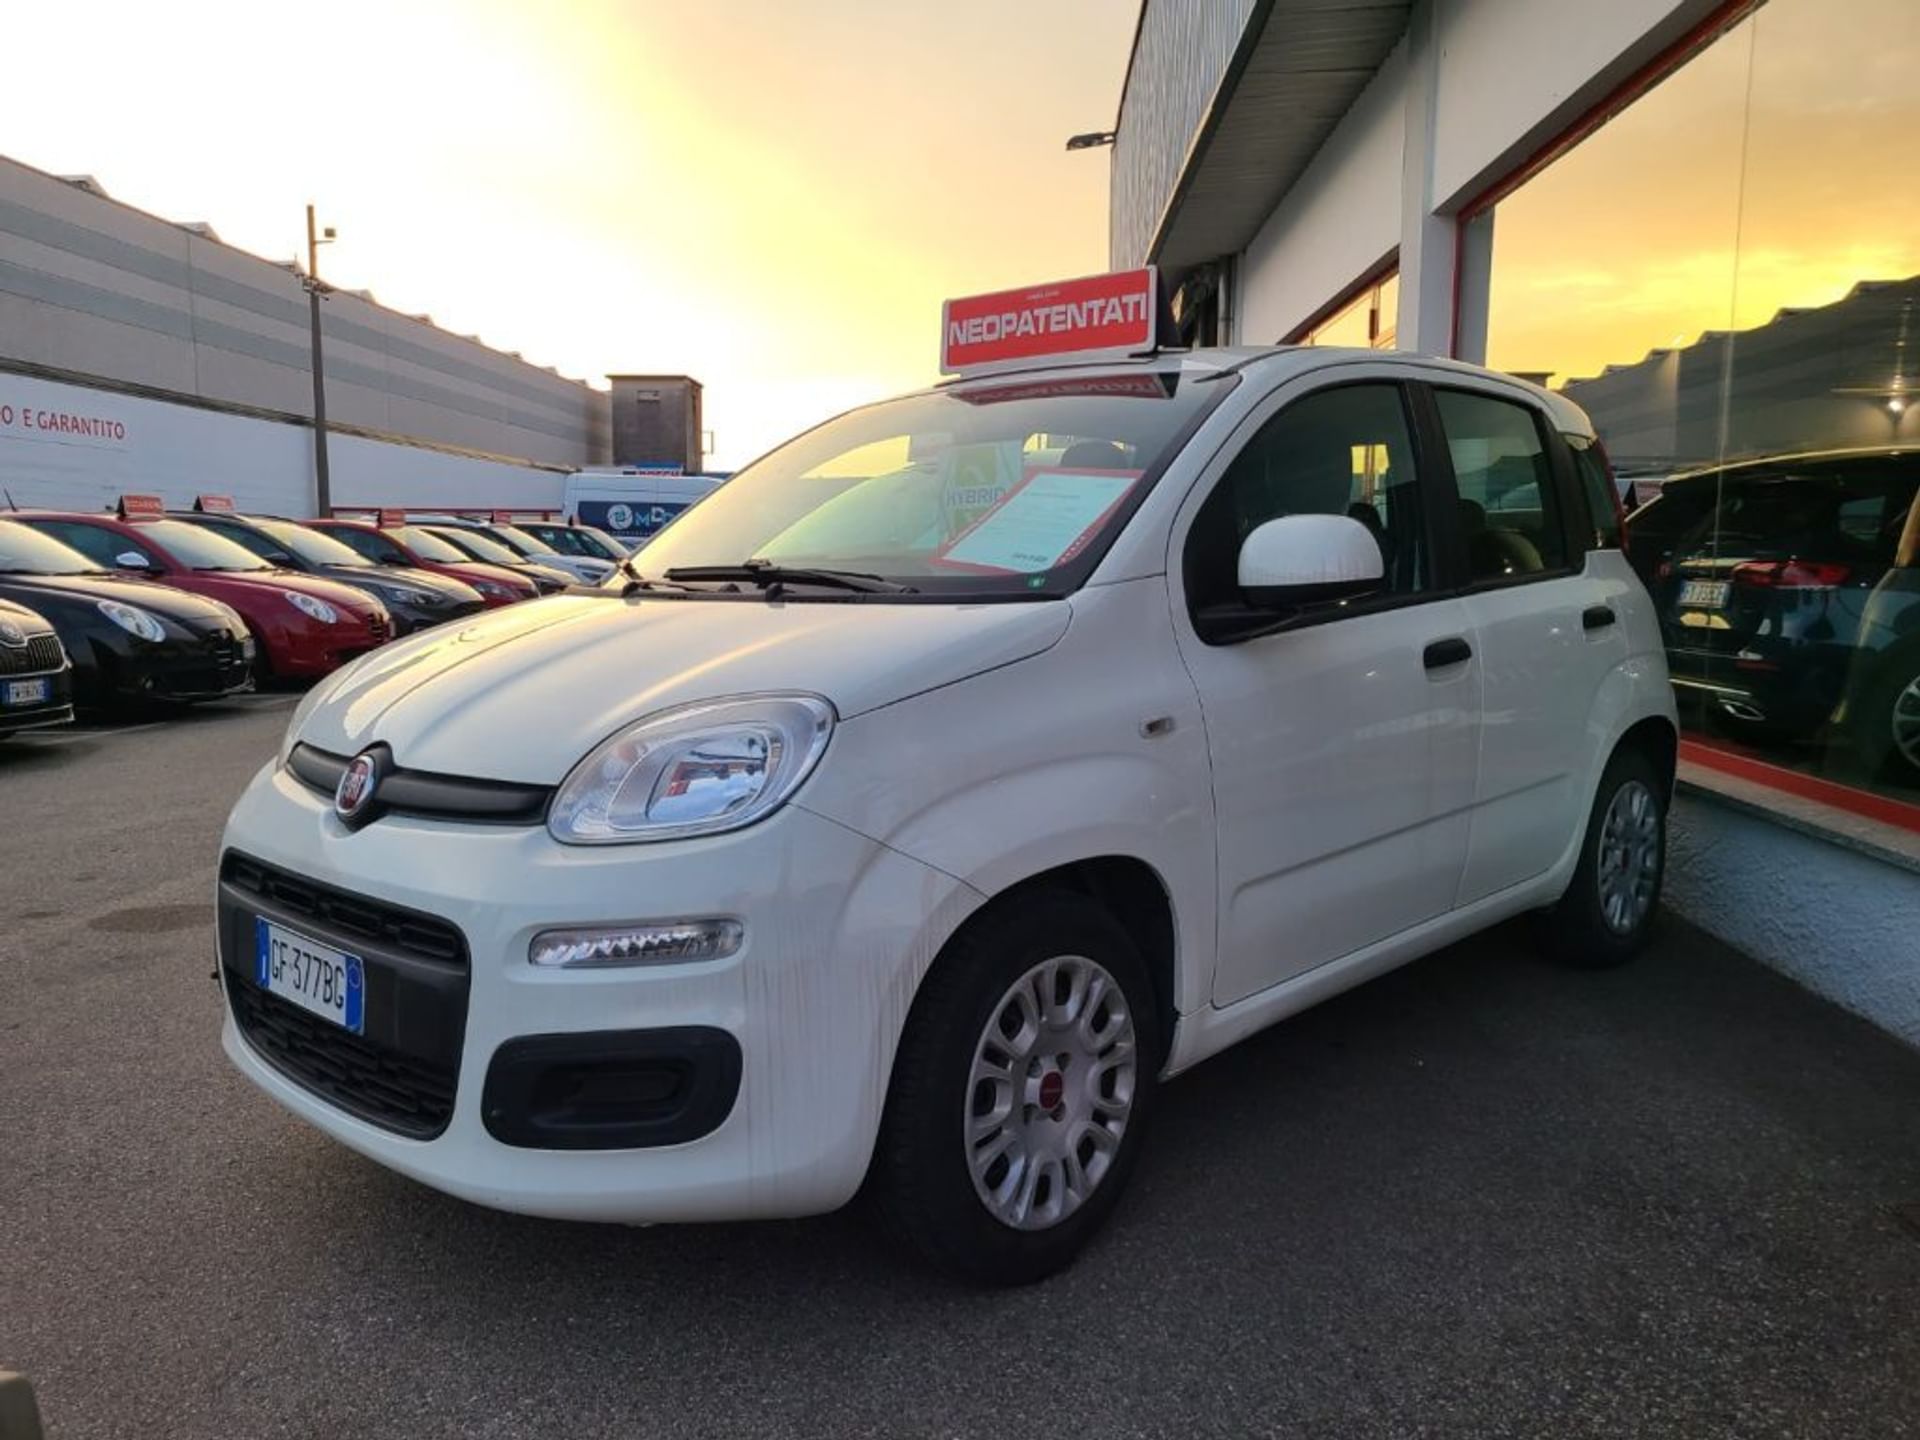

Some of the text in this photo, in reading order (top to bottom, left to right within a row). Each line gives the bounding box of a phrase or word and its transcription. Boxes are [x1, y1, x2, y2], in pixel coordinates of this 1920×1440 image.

[949, 293, 1148, 346] NEOPATENTATI
[22, 408, 33, 427] E
[37, 411, 125, 440] GARANTITO
